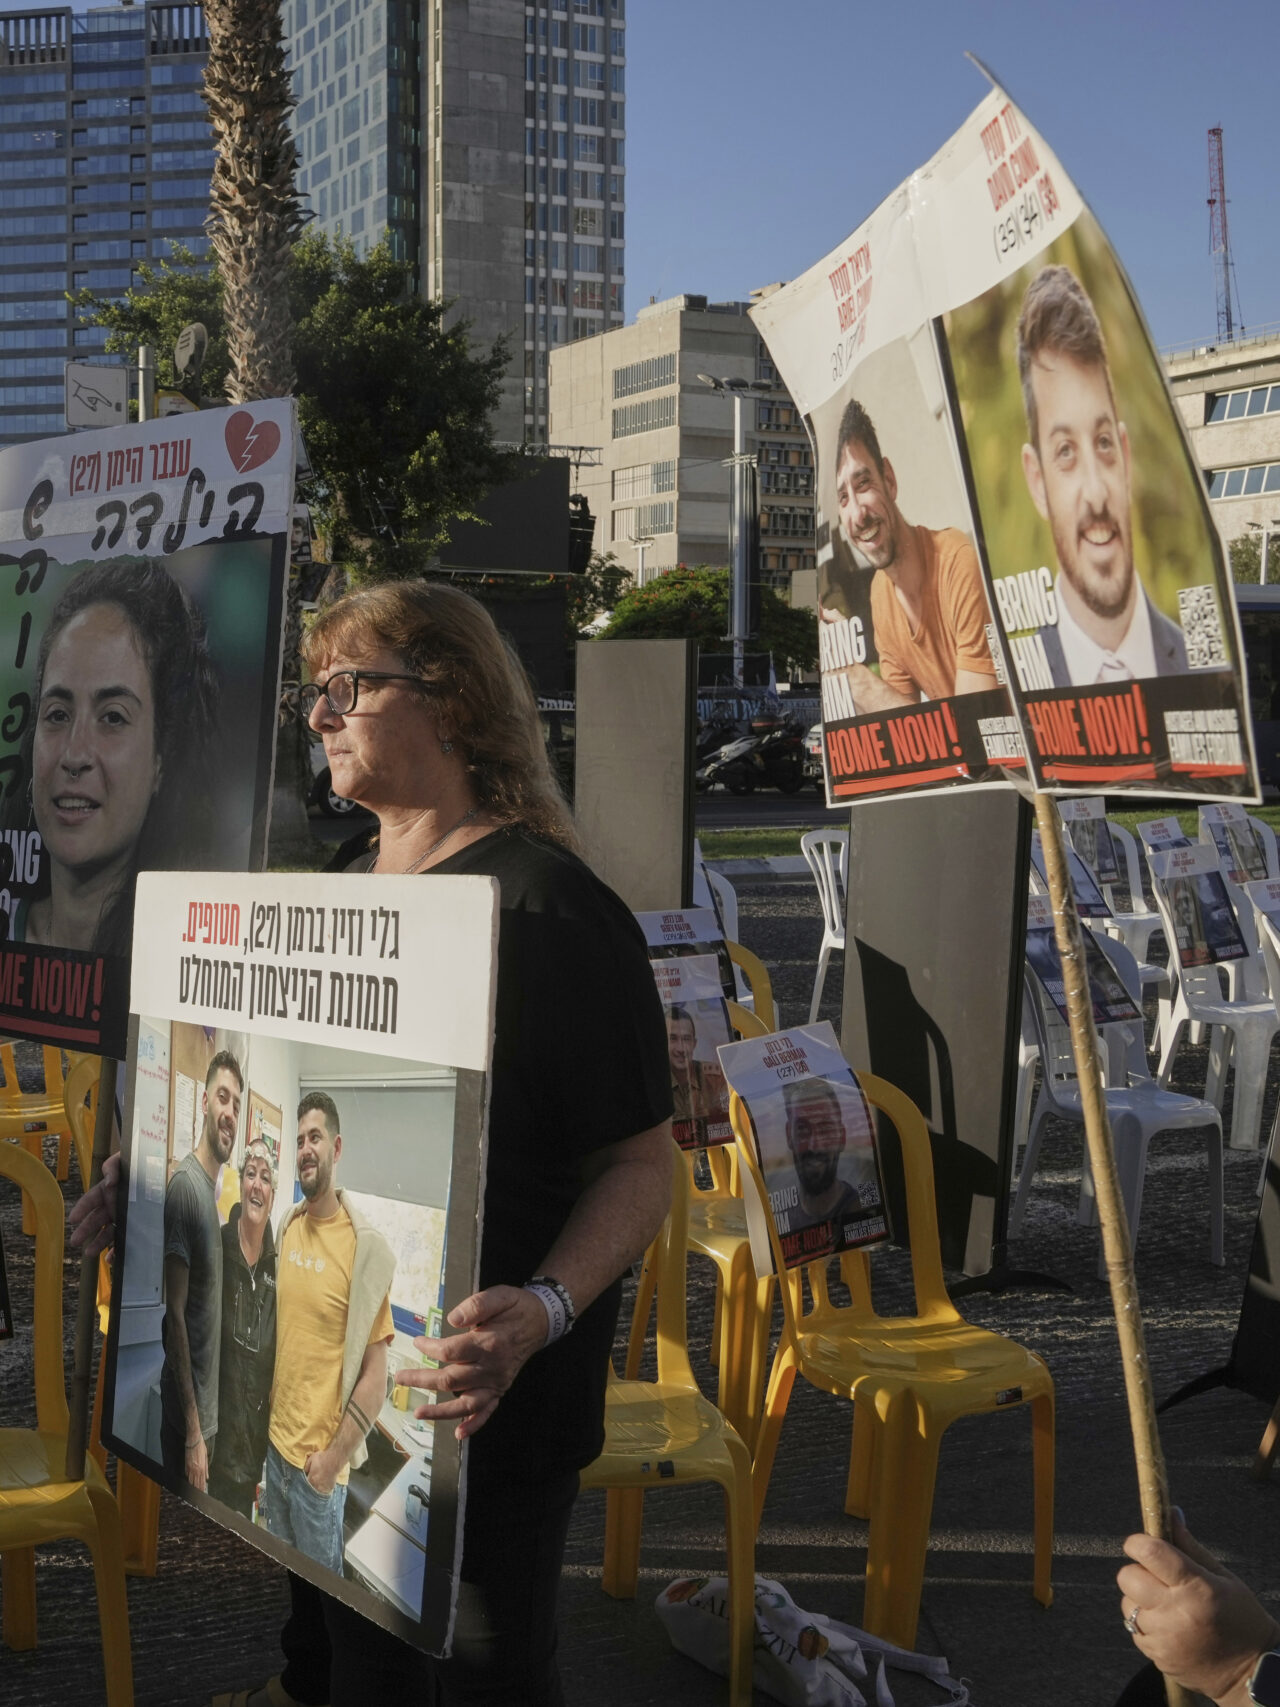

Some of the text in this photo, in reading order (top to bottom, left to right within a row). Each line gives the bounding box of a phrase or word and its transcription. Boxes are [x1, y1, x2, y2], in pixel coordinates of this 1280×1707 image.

[69, 438, 192, 497] ענבר הימן (27)
[91, 467, 266, 554] הילדה
[993, 565, 1059, 633] BRING
[819, 615, 867, 673] RING
[1007, 633, 1056, 694] HIM
[826, 719, 891, 778] HOME
[885, 702, 965, 768] NOW!
[1025, 700, 1088, 757] HOME
[1078, 683, 1153, 756] NOW!
[182, 900, 400, 960] גלי וזיו ברמן (27), חטופים.
[30, 957, 105, 1023] NOW!
[179, 953, 399, 1035] תמונת הניצחון המוחלט
[762, 1047, 808, 1069] GALI BERMAN
[776, 1065, 796, 1080] (27)
[780, 1037, 794, 1049] גלי
